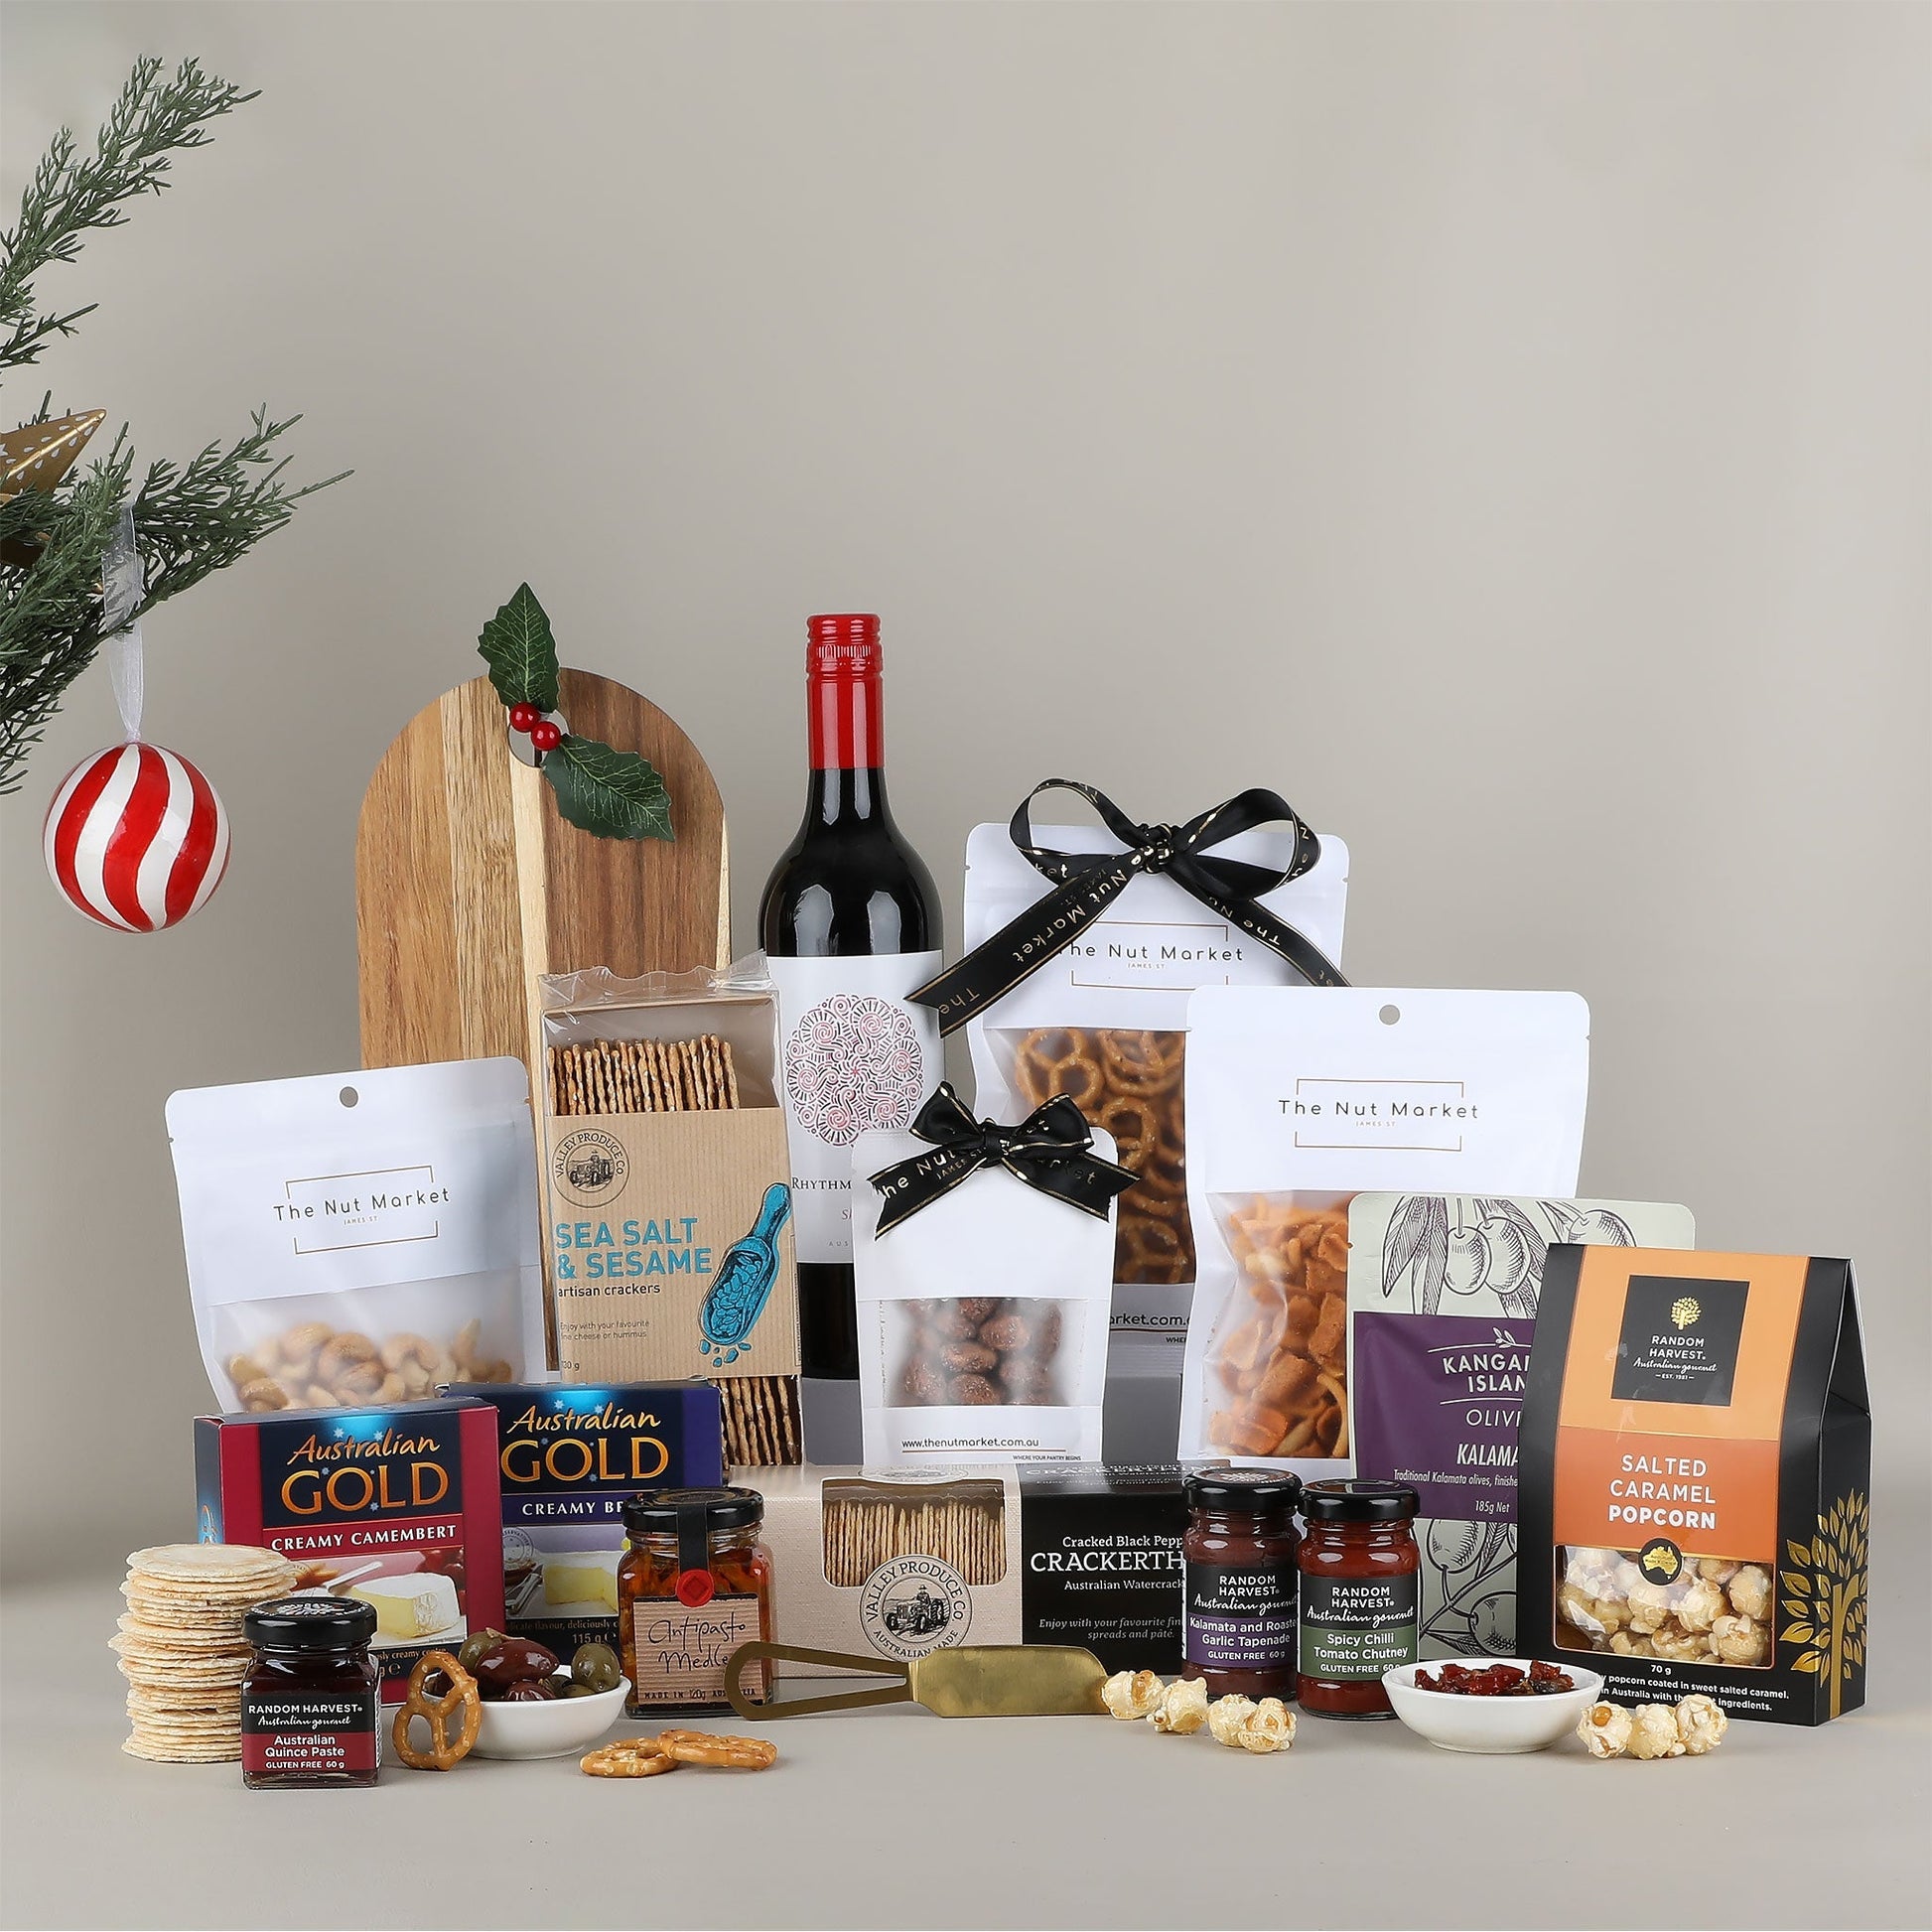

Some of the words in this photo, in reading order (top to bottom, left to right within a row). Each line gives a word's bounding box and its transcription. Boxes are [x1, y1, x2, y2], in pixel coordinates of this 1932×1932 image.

[1089, 869, 1128, 902] Nut
[1013, 905, 1086, 962] Market
[1243, 919, 1281, 945] The
[1059, 942, 1096, 957] he
[1109, 944, 1148, 959] Nut
[1162, 946, 1243, 961] Market
[939, 988, 980, 1015] The
[1279, 1099, 1321, 1115] The
[1335, 1101, 1378, 1116] Nut
[1392, 1102, 1478, 1119] Market
[555, 1137, 577, 1178] VALLEY
[577, 1132, 622, 1160] PRODUCE
[273, 1204, 315, 1221] The
[325, 1197, 361, 1215] Nut
[371, 1187, 450, 1209] Market
[344, 1217, 366, 1226] JAMES
[556, 1220, 616, 1249] SEA
[622, 1217, 698, 1246] SALT
[558, 1253, 577, 1280] &
[586, 1248, 712, 1279] SESAME
[558, 1285, 601, 1298] artisan
[604, 1283, 660, 1296] crackers
[580, 1321, 596, 1330] with
[597, 1321, 614, 1330] your
[616, 1319, 649, 1328] favourite
[574, 1331, 601, 1340] cheese
[1651, 1334, 1705, 1347] RANDOM
[1633, 1356, 1681, 1369] Australian
[506, 1401, 661, 1435] Australian
[286, 1427, 440, 1465] Australian
[901, 1437, 1039, 1449] www.thenutmarket.com.au
[500, 1437, 669, 1482] GOLD
[1620, 1453, 1708, 1477] SALTED
[1393, 1468, 1431, 1482] Traditional
[1468, 1472, 1492, 1487] olives,
[281, 1461, 449, 1514] GOLD
[1609, 1479, 1716, 1504] CARAMEL
[522, 1501, 596, 1516] CREAMY
[1475, 1500, 1494, 1514] 185g
[1496, 1501, 1510, 1513] Net
[1607, 1504, 1716, 1530] POPCORN
[271, 1534, 344, 1552] CREAMY
[350, 1525, 457, 1546] CAMEMBERT
[1062, 1536, 1113, 1548] Cracked
[1116, 1536, 1151, 1548] Black
[1064, 1580, 1121, 1590] Australian
[1219, 1576, 1276, 1586] RANDOM
[866, 1566, 897, 1622] VALLEY
[897, 1561, 963, 1598] PRODUCE
[1332, 1587, 1390, 1596] RANDOM
[1194, 1592, 1258, 1610] Australian
[1038, 1618, 1068, 1630] Enjoy
[1069, 1617, 1092, 1628] with
[1093, 1619, 1118, 1630] your
[1118, 1617, 1165, 1629] favourite
[1307, 1604, 1371, 1622] Australian
[1372, 1605, 1414, 1628] gourmet
[1189, 1616, 1237, 1632] Kalamata
[1240, 1621, 1263, 1632] and
[572, 1632, 592, 1644] 115
[1087, 1630, 1127, 1640] spreads
[1128, 1629, 1148, 1639] and
[1202, 1633, 1235, 1646] Garlic
[1237, 1633, 1291, 1648] Tapenade
[1326, 1633, 1361, 1646] Spicy
[1364, 1632, 1394, 1645] Chilli
[874, 1630, 931, 1658] AUSTRALIAN
[391, 1649, 419, 1660] creamy
[1207, 1650, 1241, 1660] GLUTEN
[1243, 1651, 1266, 1660] FREE
[1313, 1646, 1359, 1660] Tomato
[1362, 1646, 1409, 1659] Chutney
[1320, 1663, 1354, 1673] GLUTEN
[1356, 1664, 1379, 1673] FREE
[1650, 1664, 1663, 1673] 70
[1608, 1675, 1646, 1686] popcorn
[1647, 1678, 1679, 1689] coated
[1680, 1681, 1690, 1690] in
[1691, 1683, 1718, 1693] sweet
[1720, 1686, 1747, 1695] salted
[1749, 1688, 1790, 1700] caramel.
[1611, 1687, 1651, 1699] Australia
[1652, 1692, 1672, 1701] with
[1718, 1697, 1773, 1711] ingredients.
[248, 1705, 300, 1714] RANDOM
[258, 1715, 311, 1725] Australian
[274, 1734, 336, 1745] Australian
[265, 1746, 308, 1757] Quince
[312, 1747, 345, 1757] Paste
